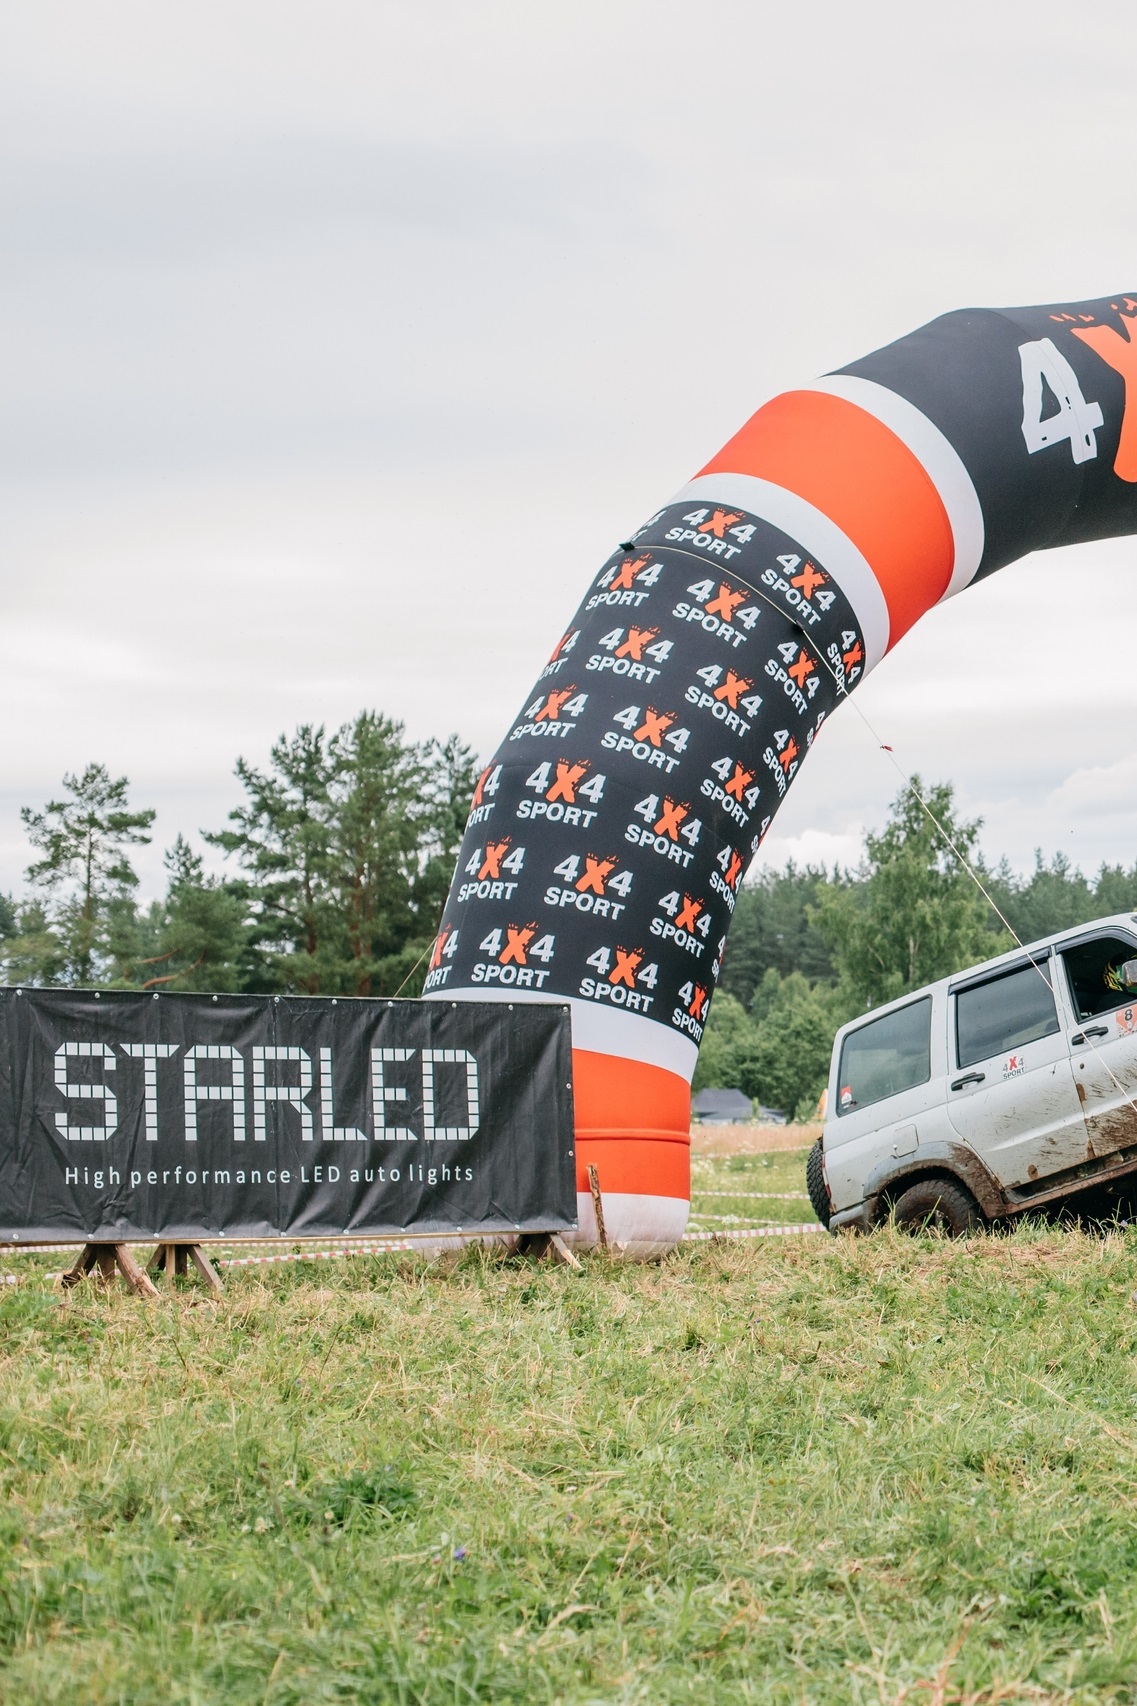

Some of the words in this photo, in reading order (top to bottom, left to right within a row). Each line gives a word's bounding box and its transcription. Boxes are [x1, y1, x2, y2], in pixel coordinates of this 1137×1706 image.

[665, 527, 741, 560] SPORT
[683, 507, 758, 543] 4X4
[597, 554, 664, 591] 4X4
[776, 553, 836, 611] 4X4
[585, 590, 650, 611] SPORT
[687, 579, 761, 630] 4X4
[761, 569, 821, 625] SPORT
[599, 625, 674, 663] 4X4
[672, 602, 747, 648] SPORT
[586, 655, 661, 683] SPORT
[777, 641, 820, 699] 4X4
[827, 642, 846, 696] SPORT
[841, 630, 865, 684] 4X4
[524, 684, 588, 721] 4X4
[696, 664, 763, 718] 4X4
[765, 659, 807, 715] SPORT
[509, 721, 576, 741] SPORT
[613, 706, 687, 753] 4X4
[684, 686, 751, 737] SPORT
[601, 732, 680, 773] SPORT
[763, 747, 786, 797] SPORT
[774, 729, 800, 780] 4X4
[525, 758, 606, 803] 4X4
[711, 756, 760, 810] 4X4
[516, 800, 598, 828] SPORT
[634, 795, 702, 846] 4X4
[700, 779, 749, 827] SPORT
[465, 836, 525, 880] 4X4
[624, 824, 694, 868] SPORT
[457, 881, 518, 902] SPORT
[553, 853, 633, 897] 4X4
[717, 845, 744, 894] 4X4
[544, 887, 625, 920] SPORT
[709, 871, 735, 913] SPORT
[658, 892, 712, 938] 4X4
[479, 921, 555, 965] 4X4
[650, 917, 705, 958] SPORT
[471, 963, 550, 988] SPORT
[586, 945, 658, 989] 4X4
[579, 977, 654, 1012] SPORT
[678, 981, 710, 1021] 4X4
[1124, 1008, 1133, 1021] 8
[672, 1008, 702, 1042] SPORT
[1003, 1056, 1024, 1072] 4X4
[1003, 1067, 1025, 1080] SPORT
[54, 1042, 480, 1141] STARLED
[65, 1166, 121, 1189] High
[130, 1166, 291, 1188] performance
[300, 1165, 341, 1183] LED
[350, 1166, 401, 1183] auto
[409, 1164, 474, 1186] lights
